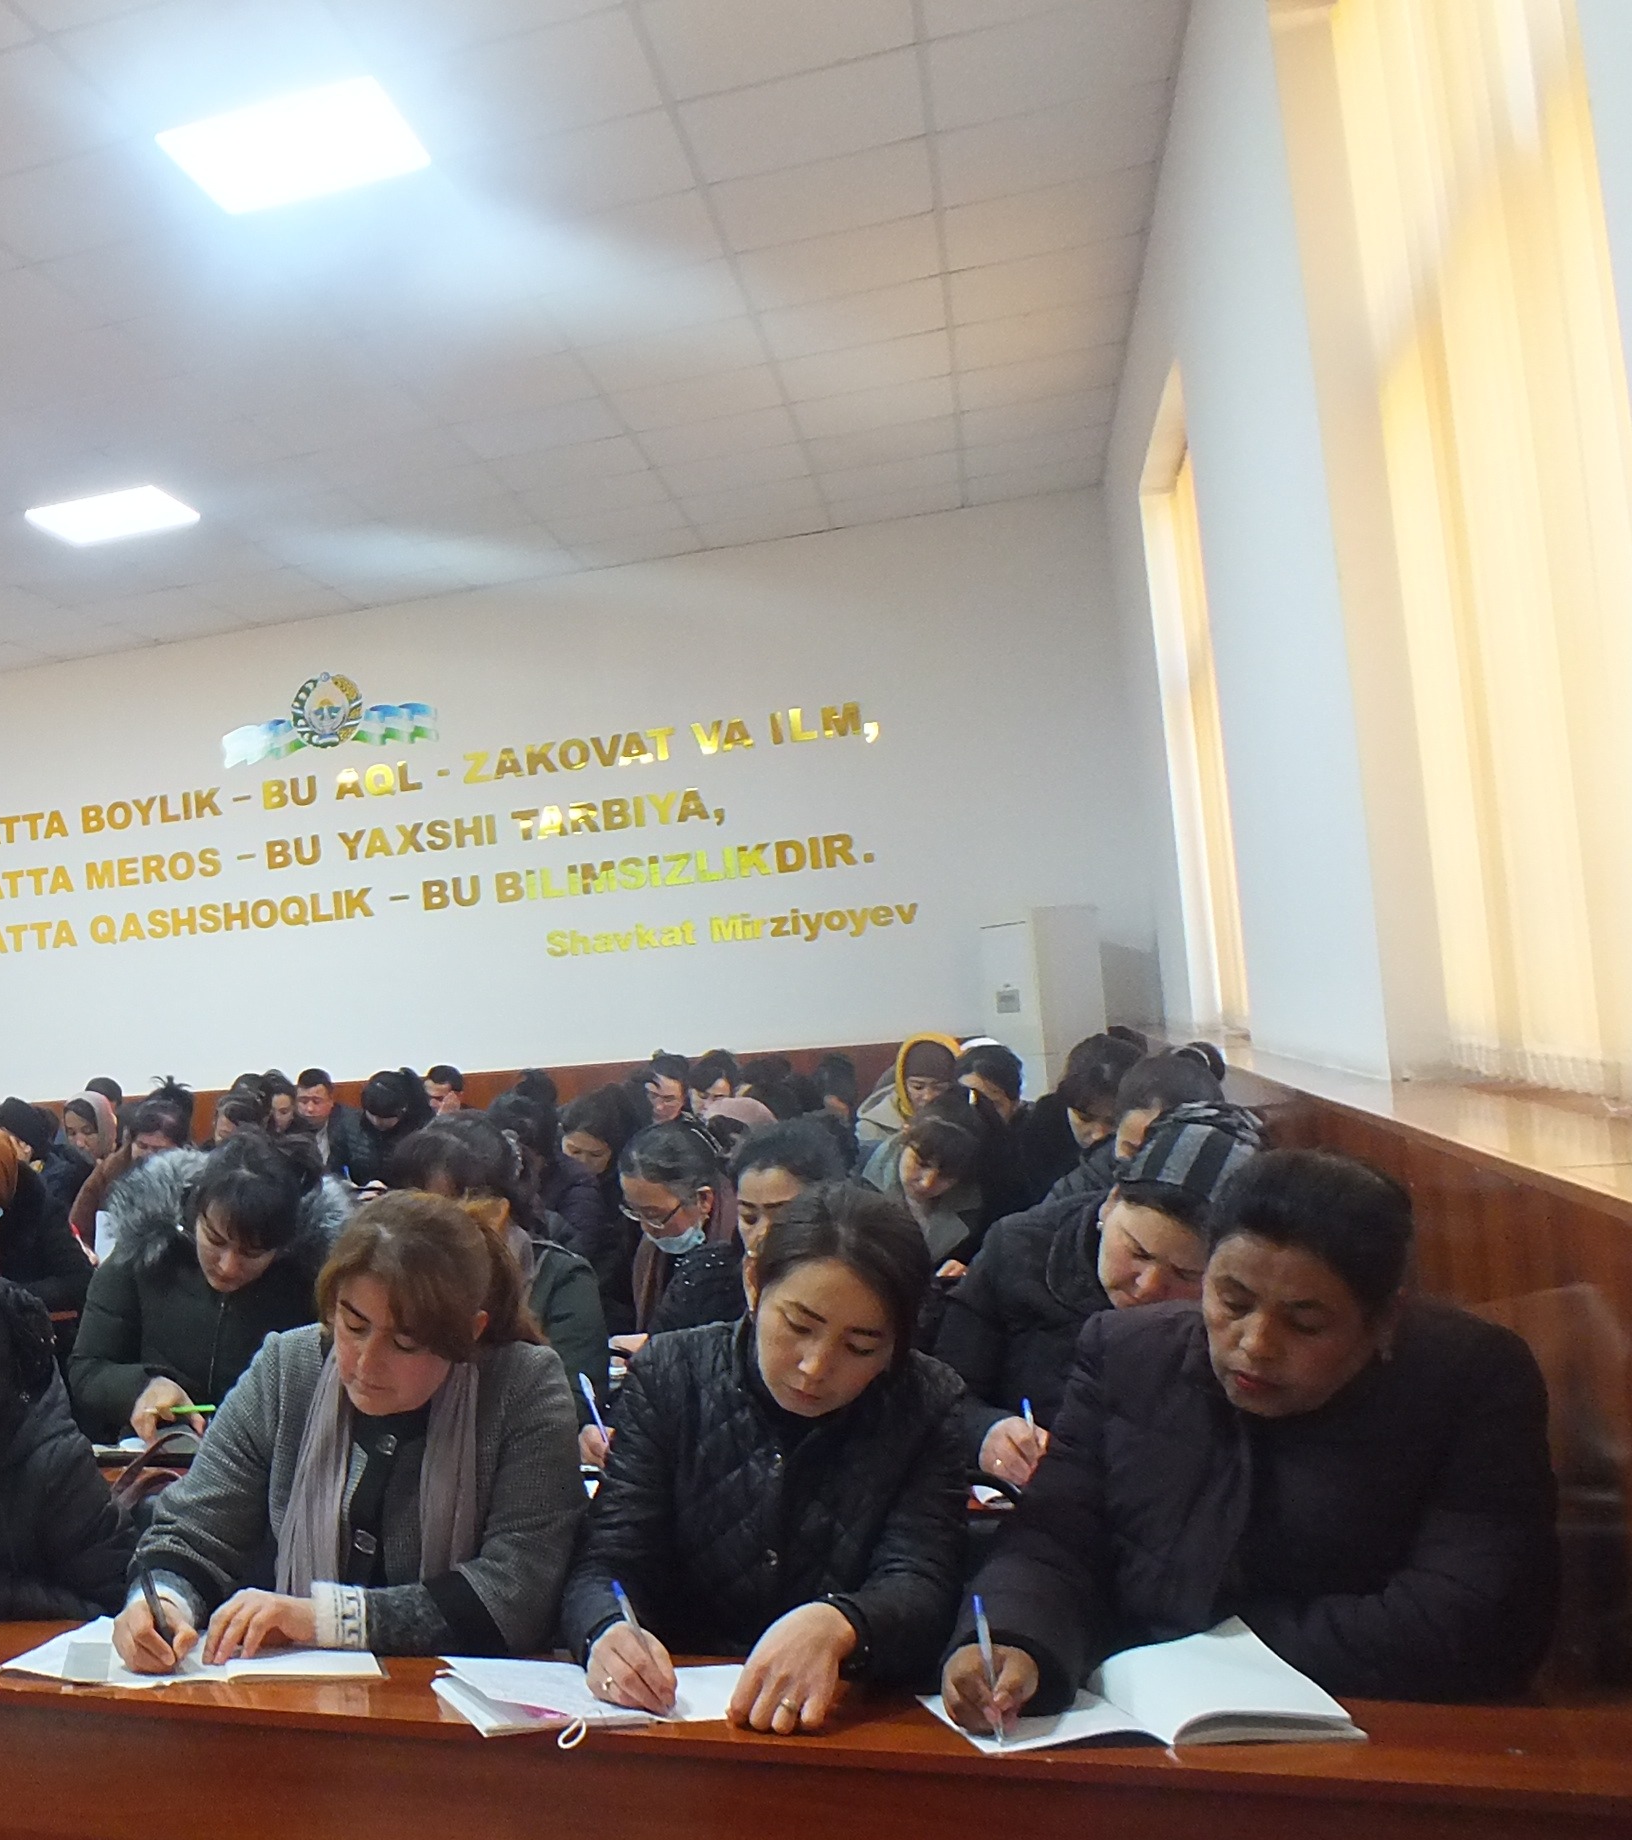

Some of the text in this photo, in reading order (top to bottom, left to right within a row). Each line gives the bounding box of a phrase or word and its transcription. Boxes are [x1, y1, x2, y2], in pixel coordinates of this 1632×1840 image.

[81, 787, 222, 834] BOYLIK
[262, 775, 317, 810] BU
[336, 760, 423, 801] AQL
[463, 727, 675, 785] ZAKOVAT
[690, 719, 754, 755] VA
[770, 702, 880, 745] ILM,
[86, 847, 223, 891] MEROS
[266, 834, 322, 870] BU
[338, 814, 497, 861] YAXSHI
[511, 787, 727, 841] TARBIYA,
[89, 887, 375, 946] QASHSHOQLIK
[423, 875, 482, 911] BU
[546, 902, 919, 958] Shavkat Mirziyoyev
